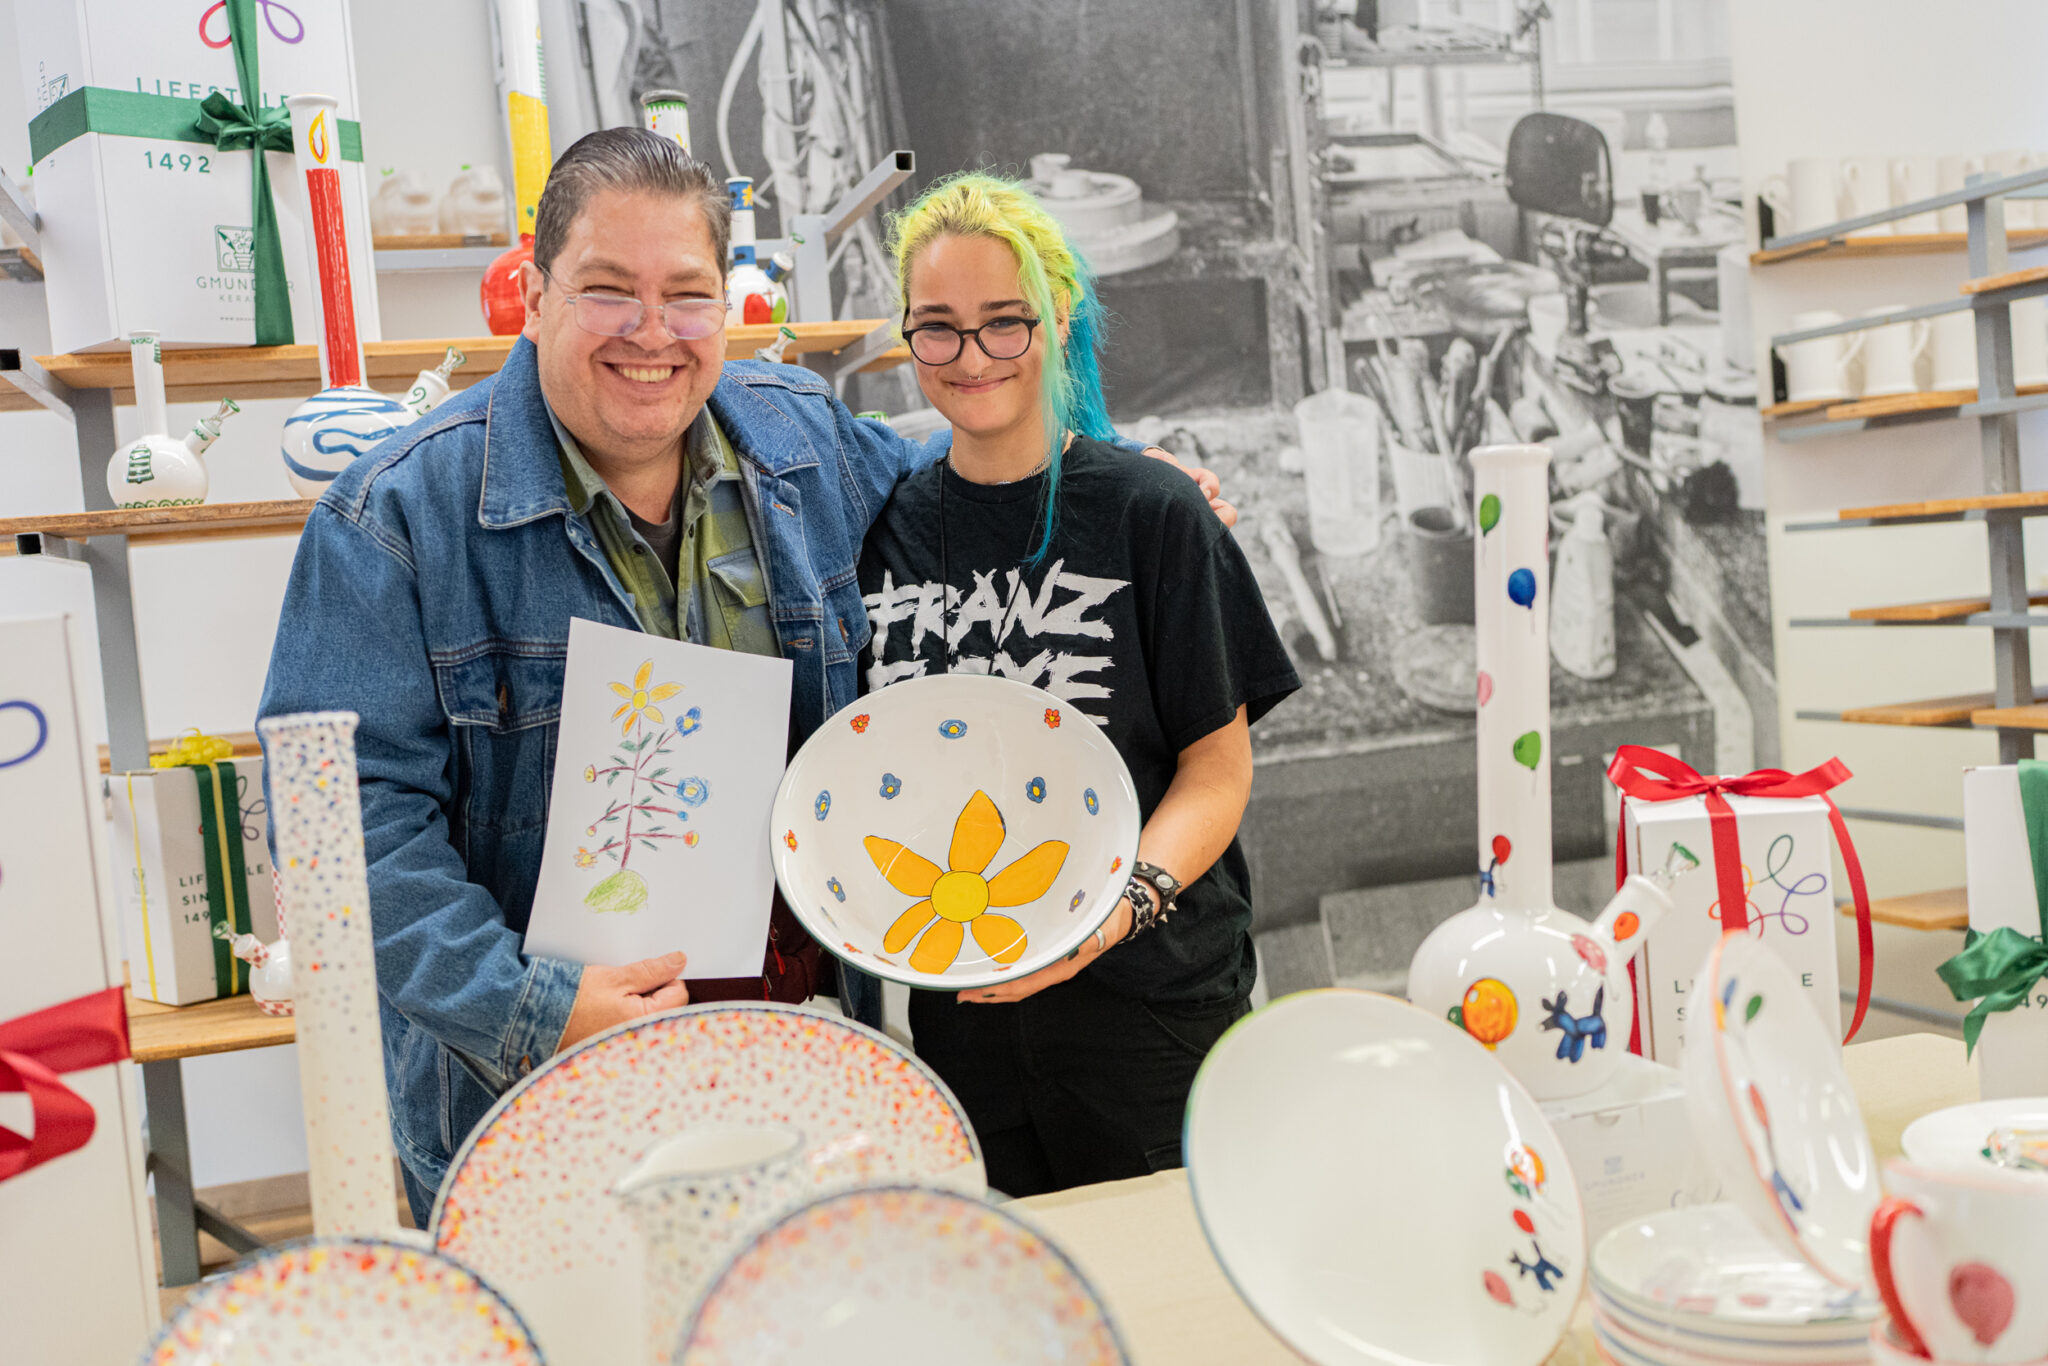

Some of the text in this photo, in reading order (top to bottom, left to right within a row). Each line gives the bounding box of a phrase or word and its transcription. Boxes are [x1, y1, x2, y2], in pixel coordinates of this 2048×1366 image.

[136, 77, 290, 109] LIFETLE
[144, 151, 211, 173] 1492
[861, 558, 1132, 661] FRANZ
[182, 892, 209, 906] SIN
[184, 910, 210, 924] 149
